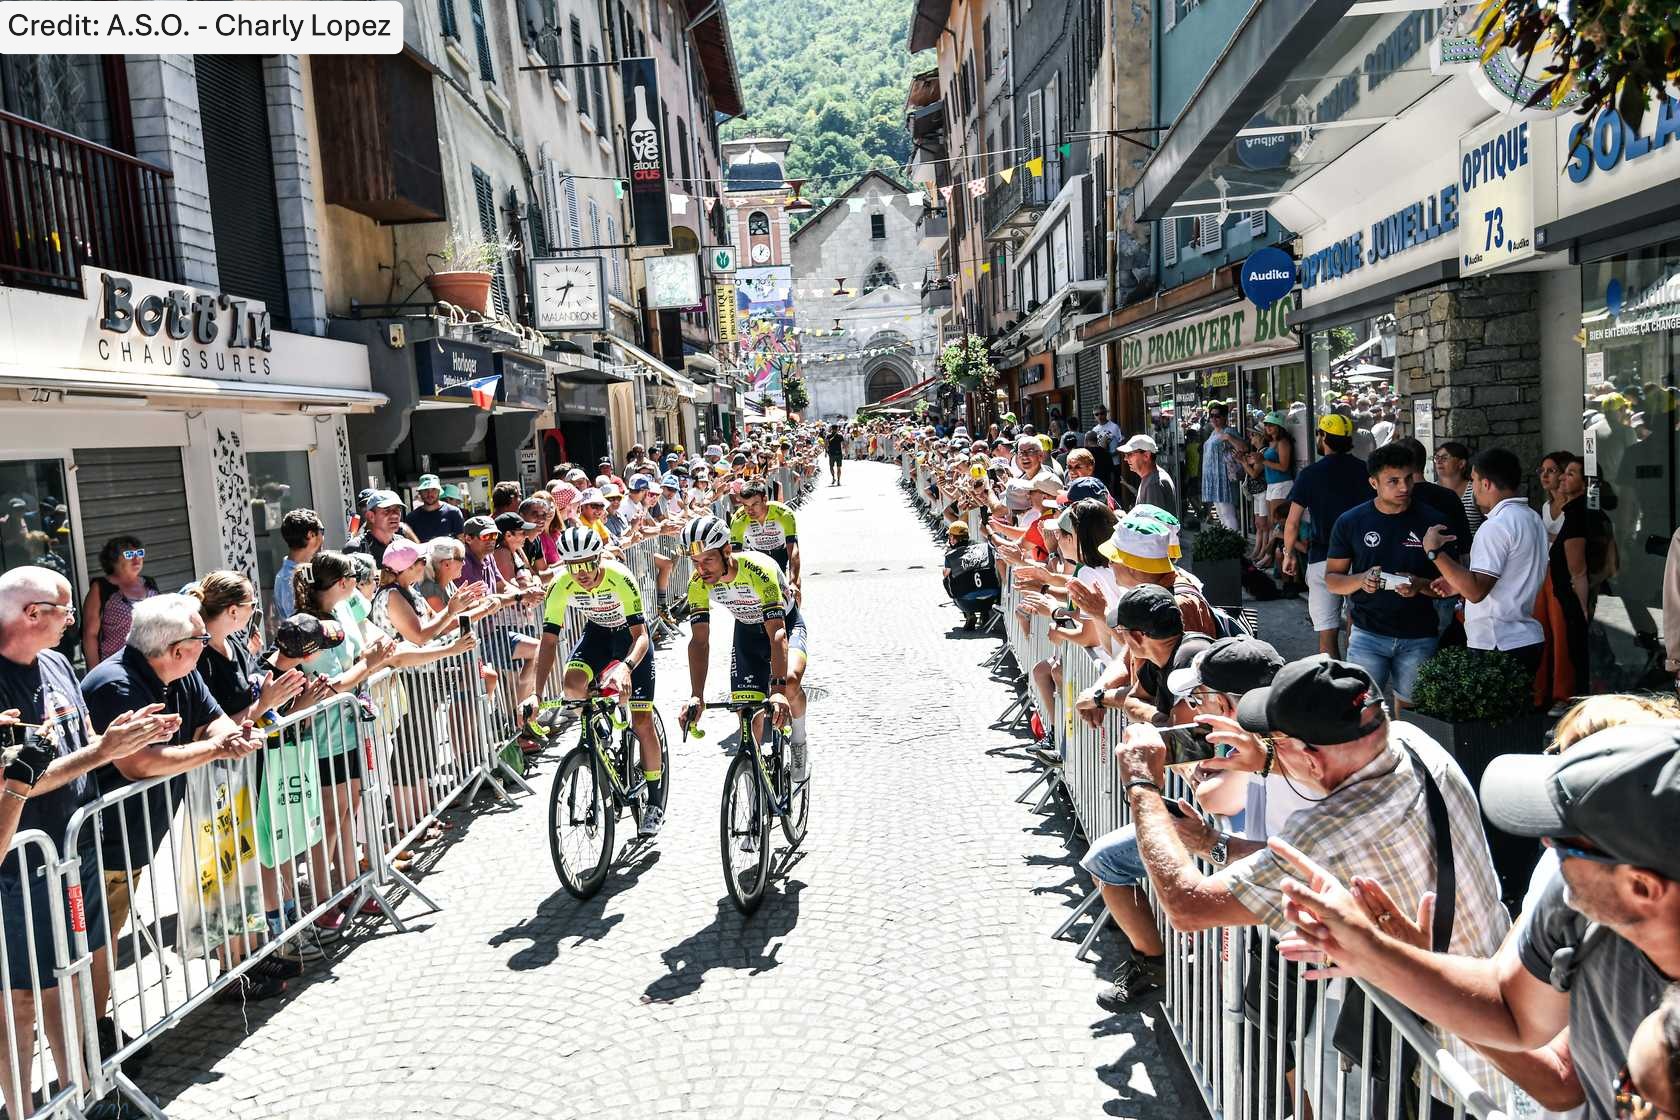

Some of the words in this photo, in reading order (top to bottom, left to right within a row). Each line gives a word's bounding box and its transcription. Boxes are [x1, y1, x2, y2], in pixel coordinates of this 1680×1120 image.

[633, 160, 660, 170] atout
[1462, 122, 1528, 193] OPTIQUE
[1484, 206, 1504, 251] 73
[1512, 238, 1530, 251] Audika
[1301, 231, 1363, 289] OPTIQUE
[1469, 255, 1483, 265] Audika
[1249, 269, 1290, 282] Audika
[542, 312, 598, 321] MALANDRONE
[1123, 340, 1143, 370] BIO
[1148, 310, 1245, 365] PROMOVERT
[1254, 295, 1294, 342] BIO
[1589, 329, 1604, 341] BIEN
[1604, 326, 1640, 339] ENTENDRE,
[1640, 323, 1650, 335] ÇA
[1651, 317, 1680, 331] CHANGE
[98, 339, 271, 375] CHAUSSURES
[452, 352, 477, 378] Horloger
[744, 560, 770, 583] Wallonie
[974, 572, 982, 588] 6
